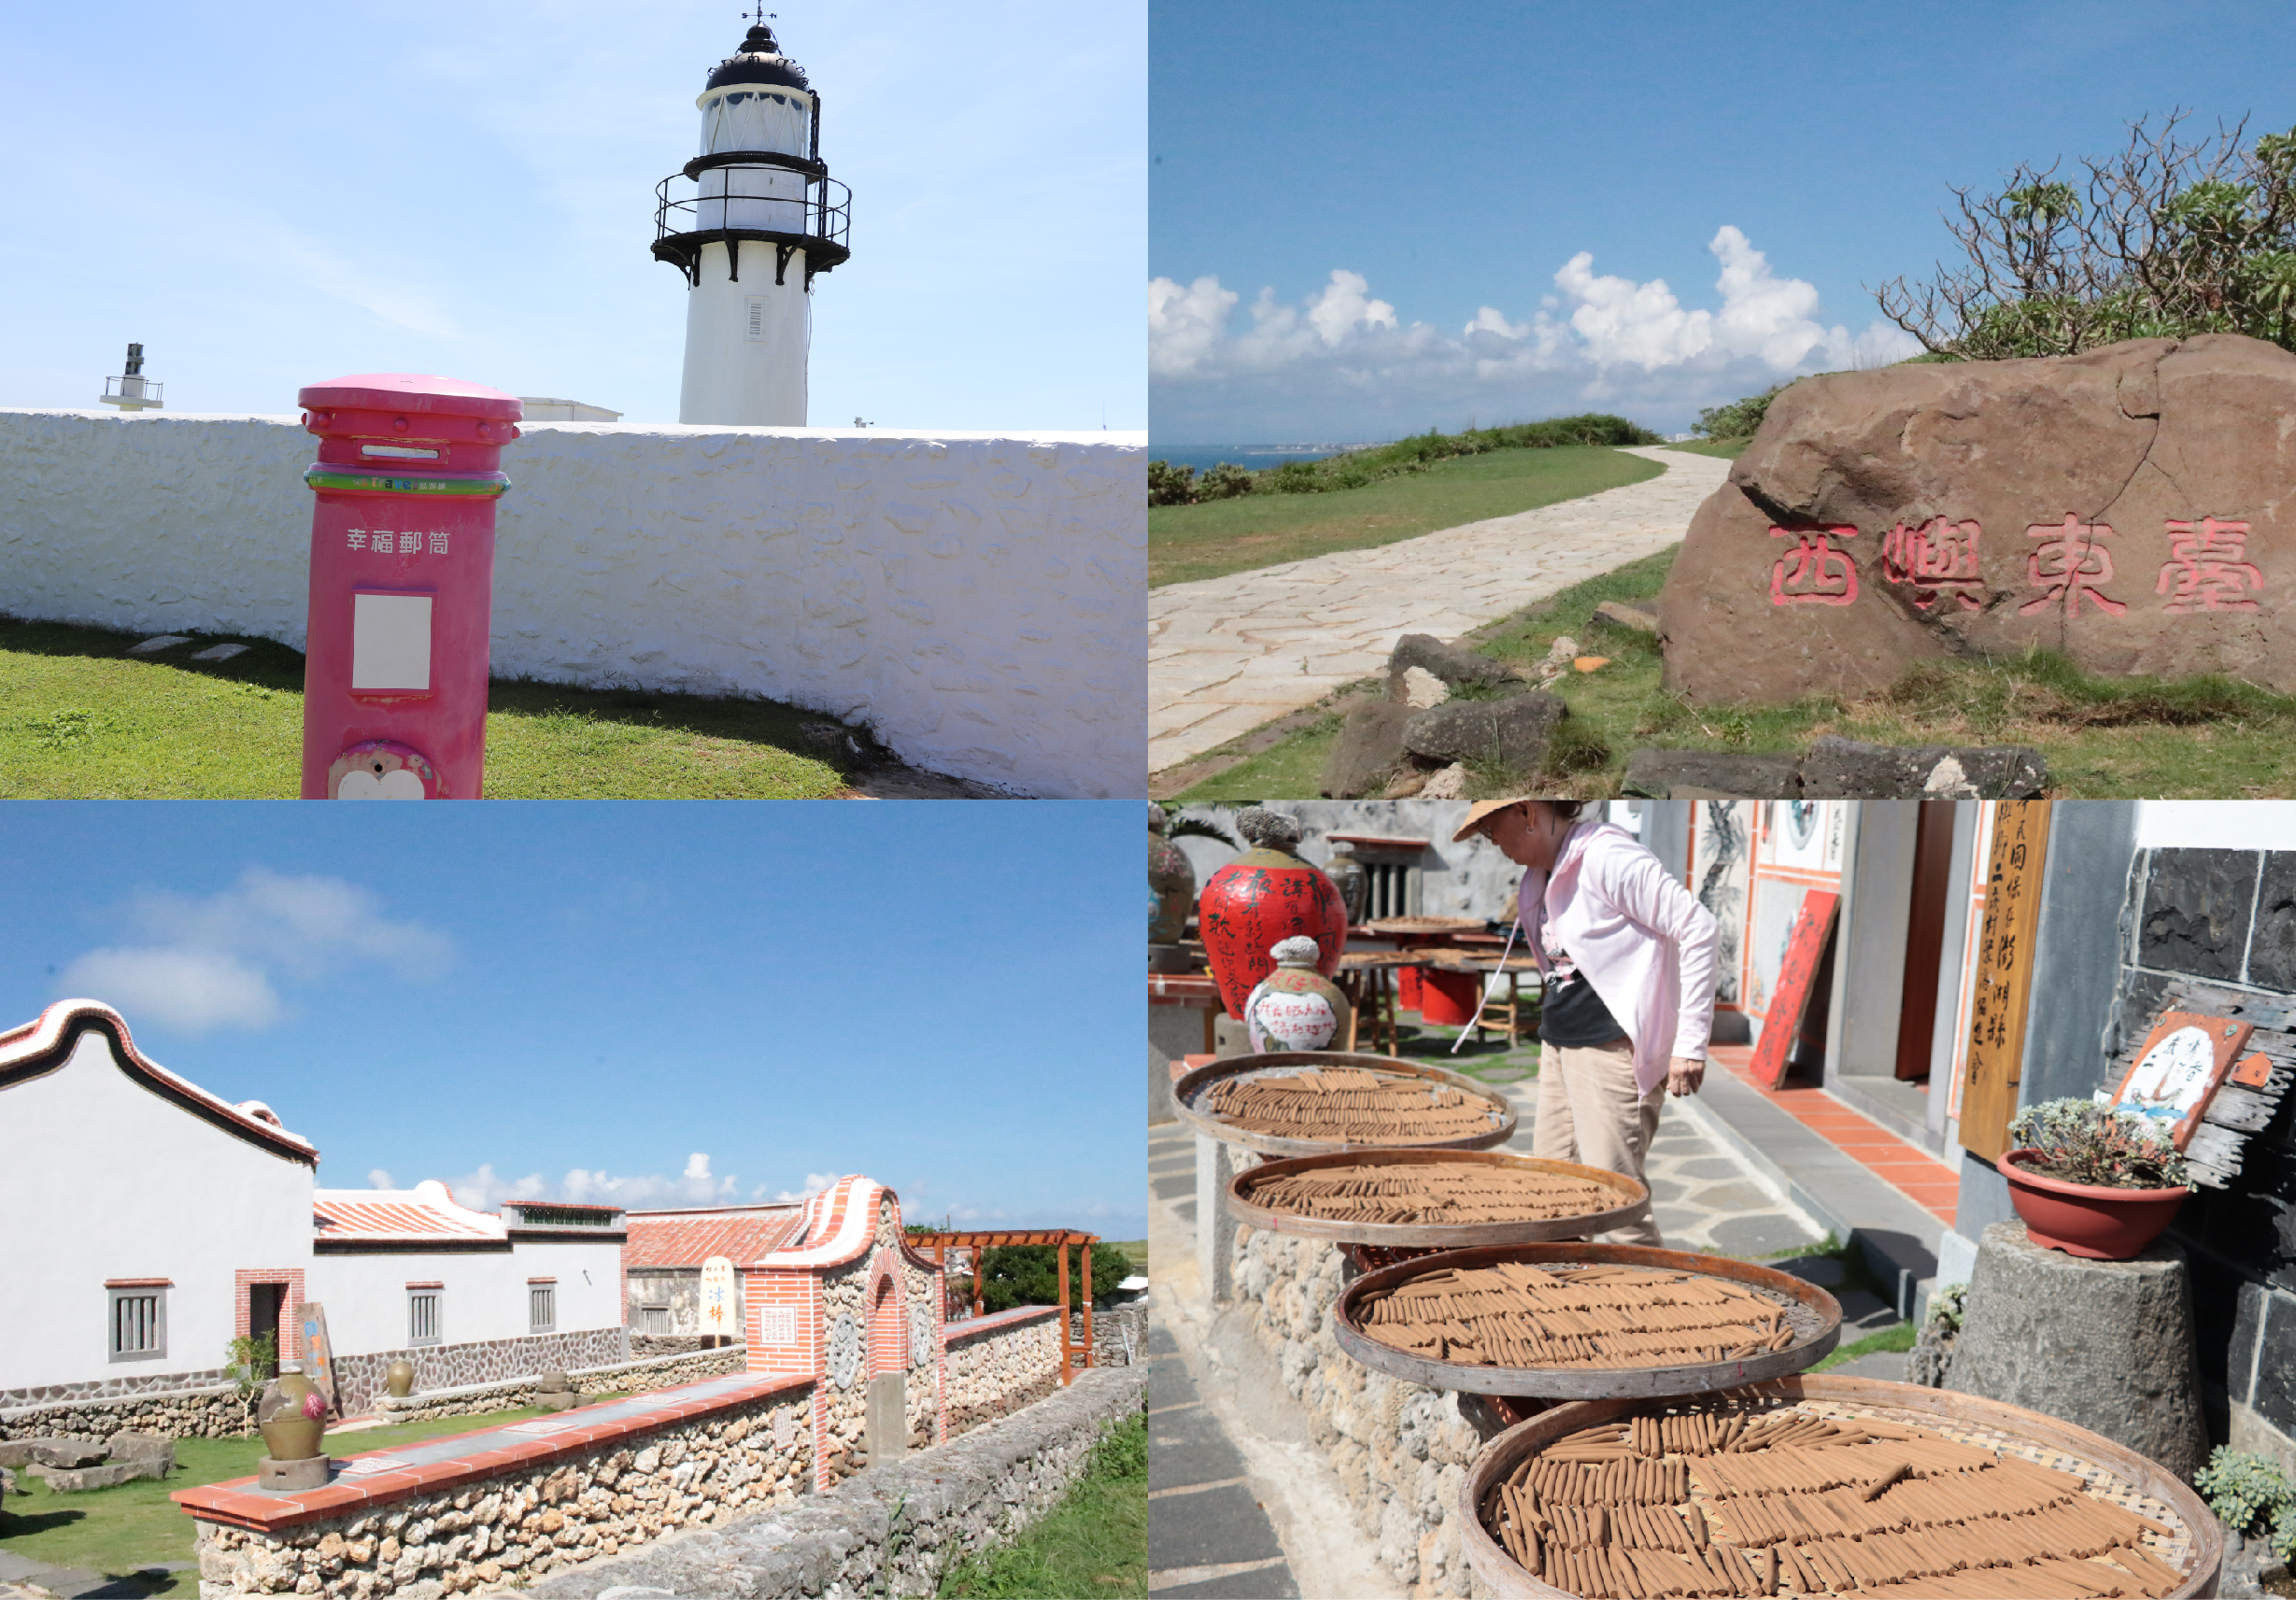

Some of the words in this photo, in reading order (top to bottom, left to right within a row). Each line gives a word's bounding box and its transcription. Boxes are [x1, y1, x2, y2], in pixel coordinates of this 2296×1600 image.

[347, 528, 450, 555] 幸福郵筒
[707, 1286, 726, 1331] 冰棒
